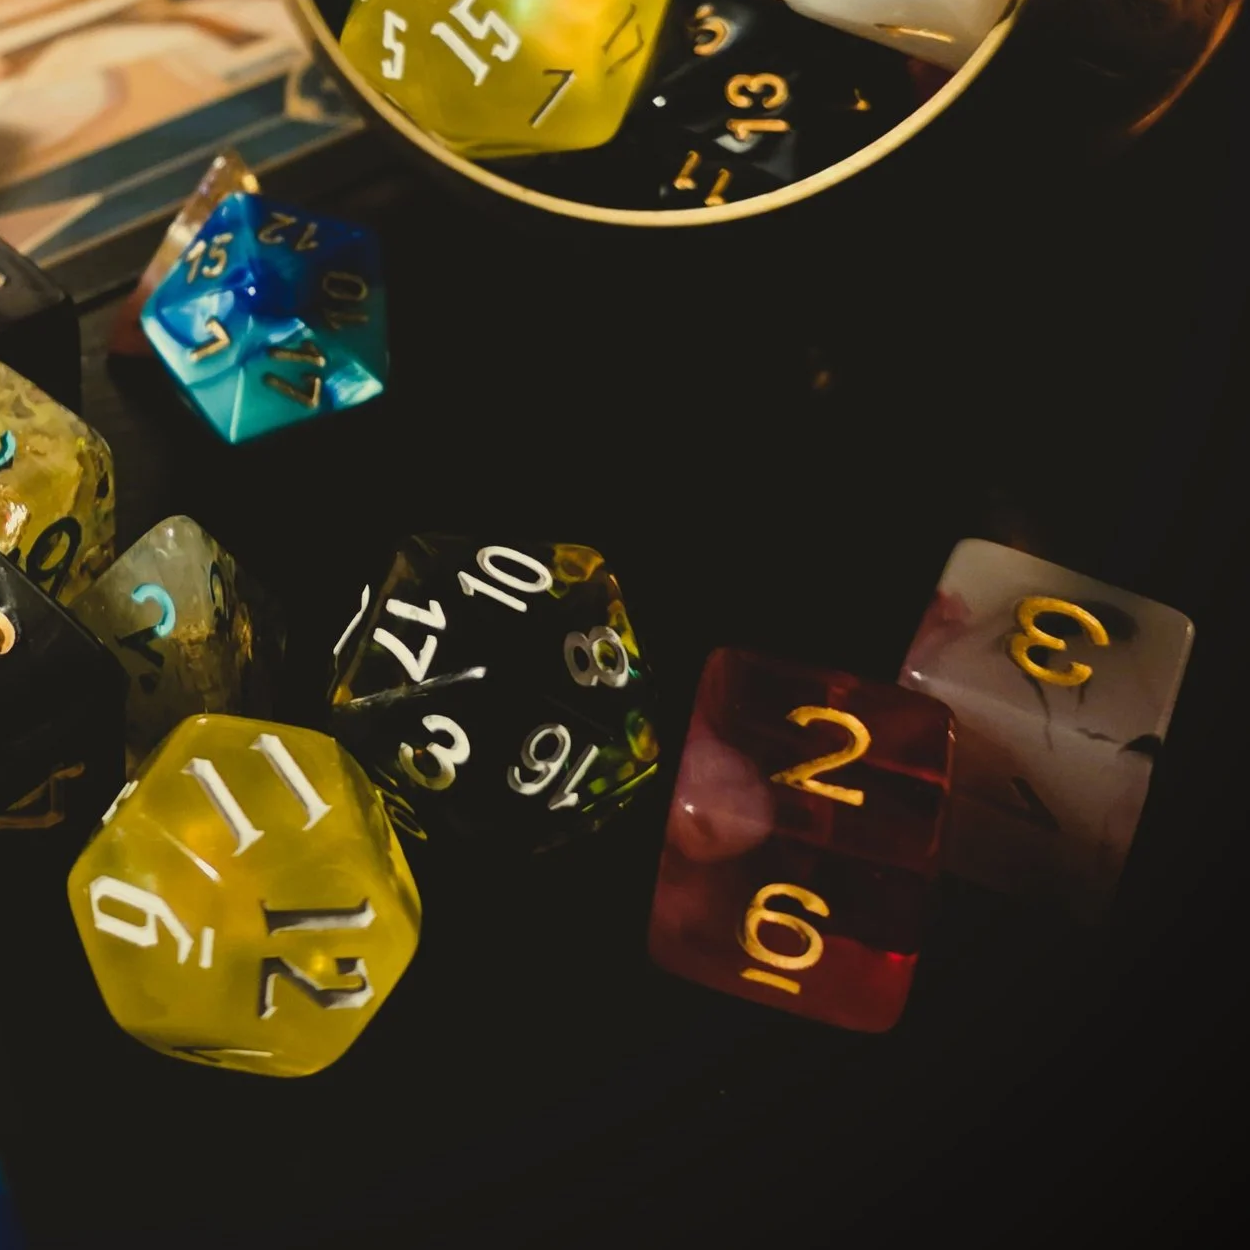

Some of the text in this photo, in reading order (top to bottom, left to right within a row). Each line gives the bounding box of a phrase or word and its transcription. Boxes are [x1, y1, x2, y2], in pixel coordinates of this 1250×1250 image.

[723, 71, 792, 143] 13
[187, 233, 234, 285] 15
[457, 545, 554, 613] 10
[372, 598, 447, 683] 17
[563, 625, 631, 688] 8
[1008, 595, 1110, 687] 3
[397, 713, 471, 791] 3
[506, 723, 600, 811] 16
[770, 704, 872, 807] 2
[180, 733, 333, 858] 11
[257, 895, 378, 1021] 12
